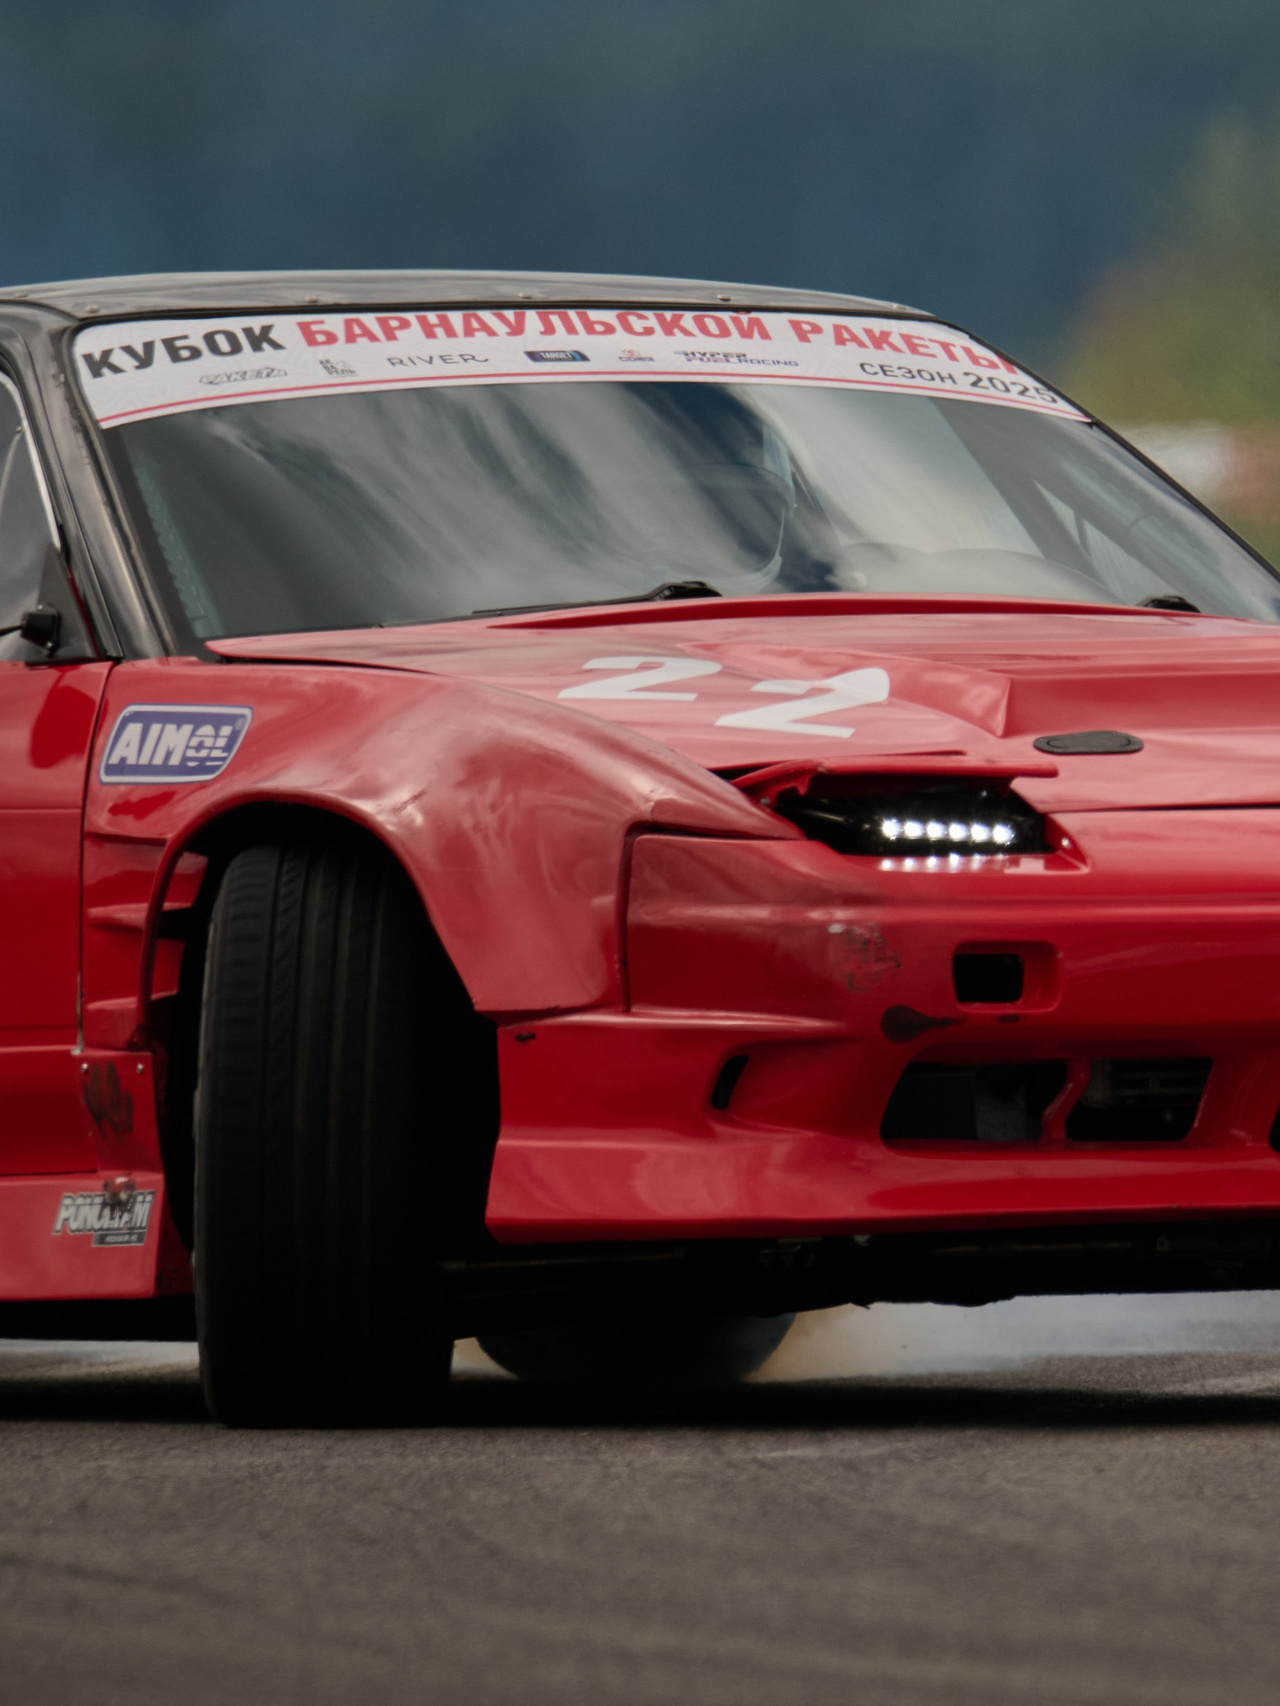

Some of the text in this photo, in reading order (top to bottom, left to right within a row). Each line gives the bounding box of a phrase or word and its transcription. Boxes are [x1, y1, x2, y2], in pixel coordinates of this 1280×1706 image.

[81, 309, 1018, 379] КУБОК БАРНАУЛЬСКОЙ РАКЕТЫ
[387, 353, 488, 367] RIVER
[860, 362, 1059, 404] СЕЗОН 2025
[557, 656, 890, 739] 22
